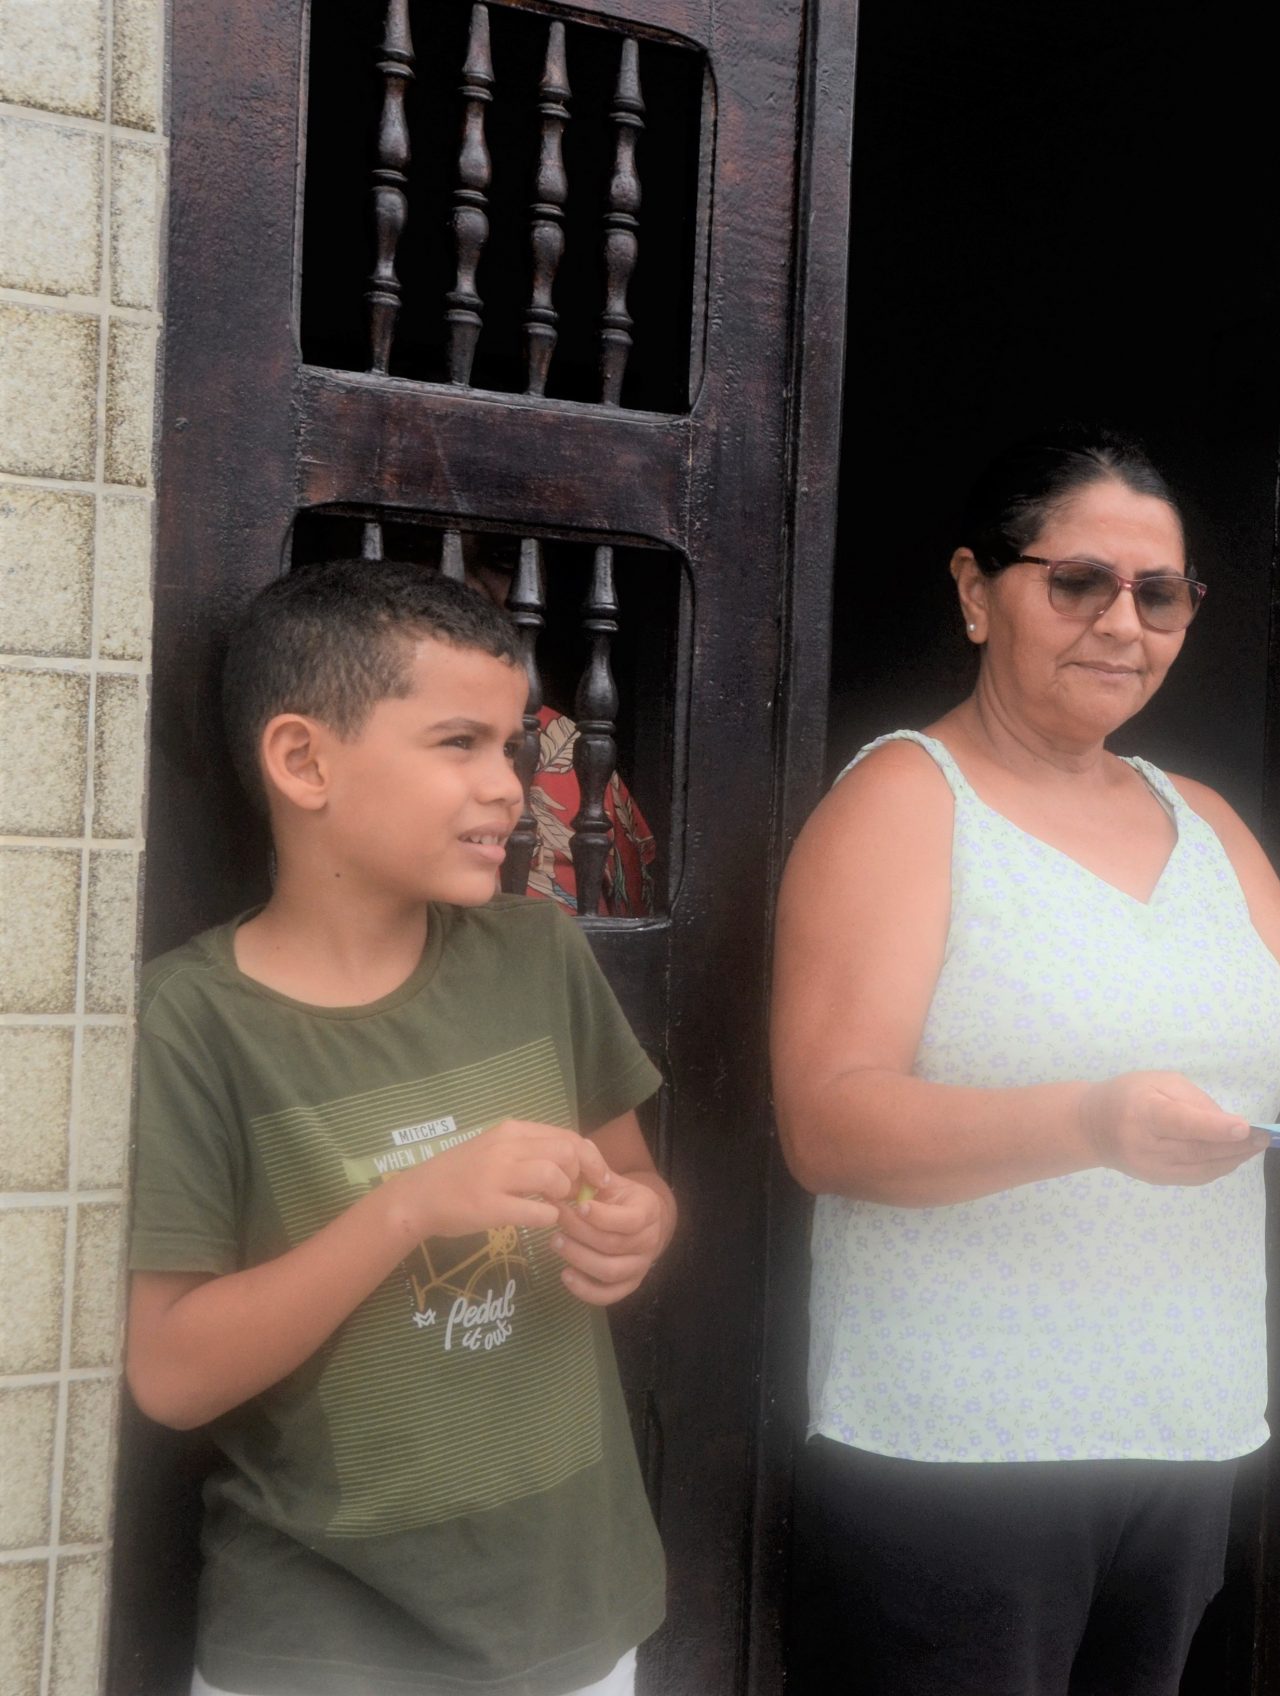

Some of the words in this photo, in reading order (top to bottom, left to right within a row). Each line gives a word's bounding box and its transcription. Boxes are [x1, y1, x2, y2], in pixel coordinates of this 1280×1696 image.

[399, 1120, 450, 1144] MITCH'S
[374, 1150, 415, 1173] WHEN
[420, 1143, 434, 1161] IN
[444, 1279, 516, 1350] Pedal
[462, 1327, 482, 1350] it
[484, 1320, 512, 1350] out
